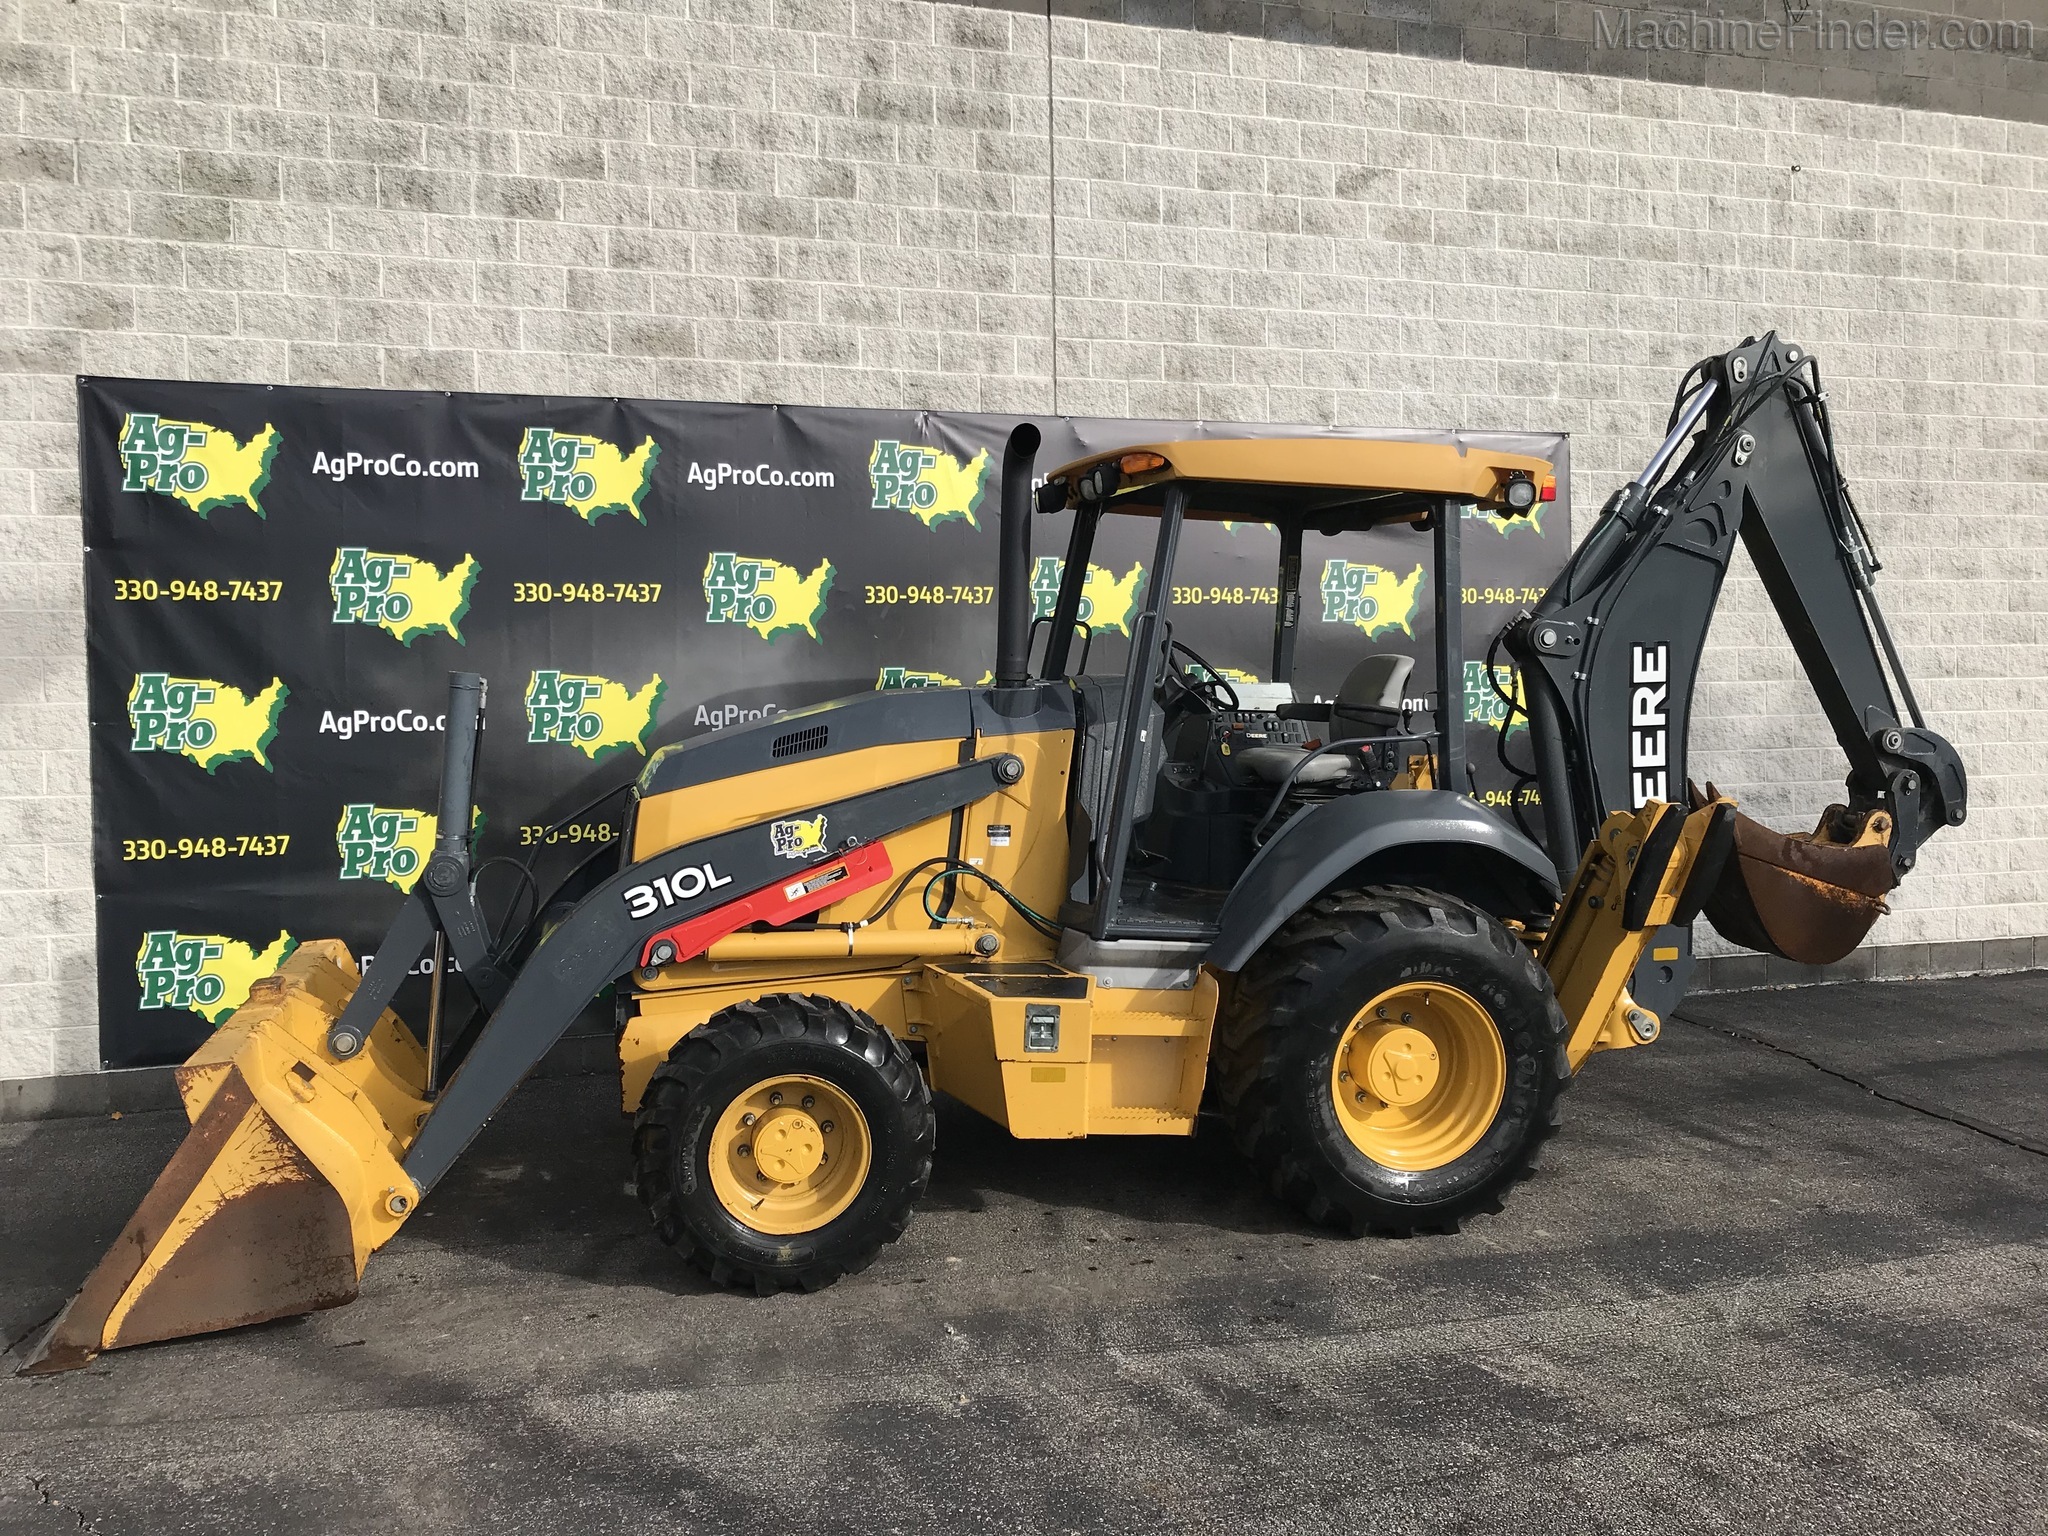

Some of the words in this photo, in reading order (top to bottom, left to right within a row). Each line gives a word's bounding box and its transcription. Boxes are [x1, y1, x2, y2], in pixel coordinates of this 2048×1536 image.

[122, 413, 206, 460] Ag-
[521, 427, 593, 470] Ag-
[122, 454, 208, 491] Pro
[311, 451, 479, 482] AgProCo.com
[687, 462, 835, 490] AgProCo.com
[871, 440, 935, 481] Ag-
[520, 464, 596, 500] Pro
[870, 474, 937, 508] Pro
[332, 547, 410, 594] Ag-
[707, 552, 774, 592] Ag-
[1032, 557, 1093, 590] A-
[1323, 559, 1376, 597] Ag-
[114, 579, 283, 602] 330-948-7437
[331, 587, 412, 623] Pro
[513, 582, 662, 603] 330-948-7437
[706, 587, 776, 623] Pro
[864, 585, 994, 605] 330-948-7437
[1032, 590, 1094, 622] Po
[1322, 590, 1378, 622] Pro
[131, 672, 215, 719] Ag-
[529, 671, 600, 713] Ag-
[1463, 691, 1510, 722] Pro
[130, 713, 215, 751] Pro
[528, 707, 602, 743] Pro
[340, 803, 416, 849] Ag-
[774, 823, 801, 839] Ag-
[776, 836, 803, 852] Pro
[122, 836, 290, 861] 330-948-7437
[339, 842, 418, 880] Pro
[623, 863, 732, 918] 310L
[140, 930, 222, 977] Ag-
[140, 970, 223, 1011] Pro
